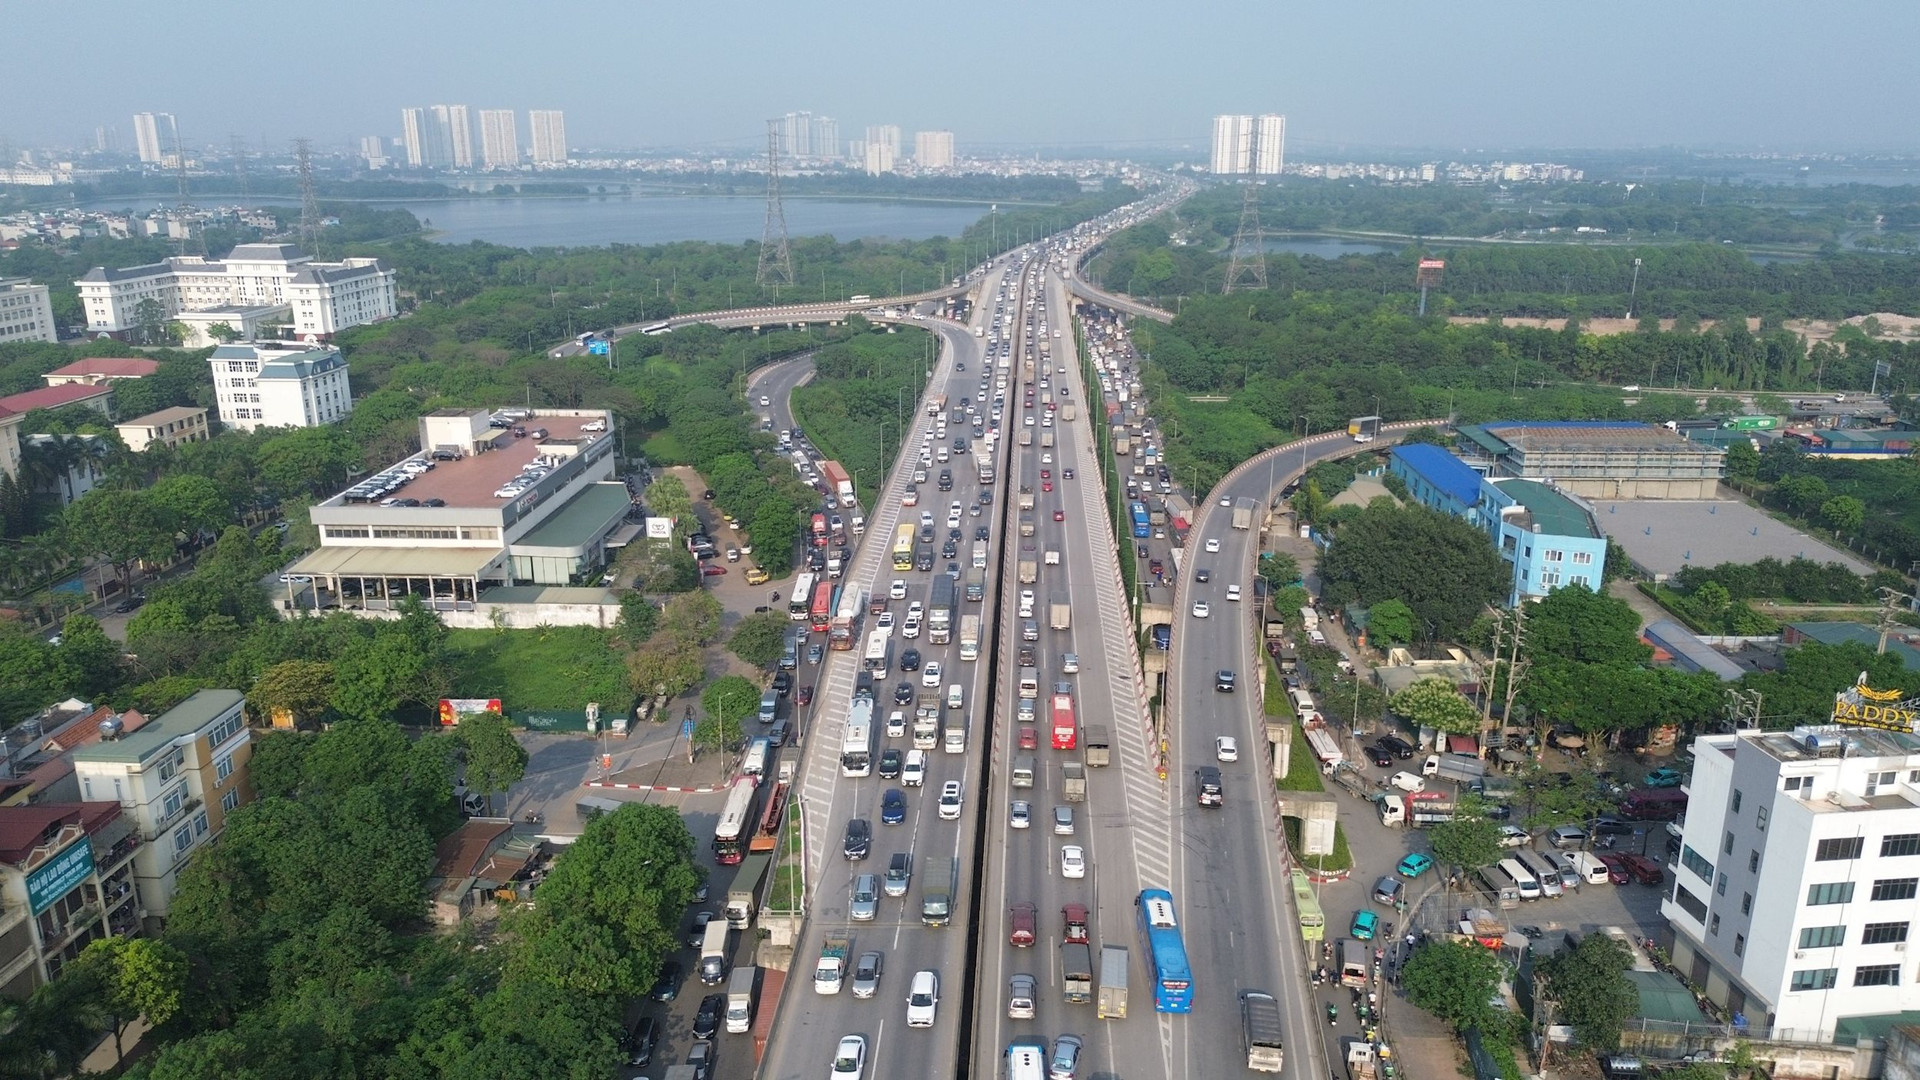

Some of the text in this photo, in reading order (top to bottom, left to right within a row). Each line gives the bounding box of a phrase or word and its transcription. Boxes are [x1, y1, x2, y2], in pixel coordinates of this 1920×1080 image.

[1835, 702, 1916, 725] PADDY
[47, 867, 58, 881] LAO
[56, 857, 71, 875] ĐỘNG
